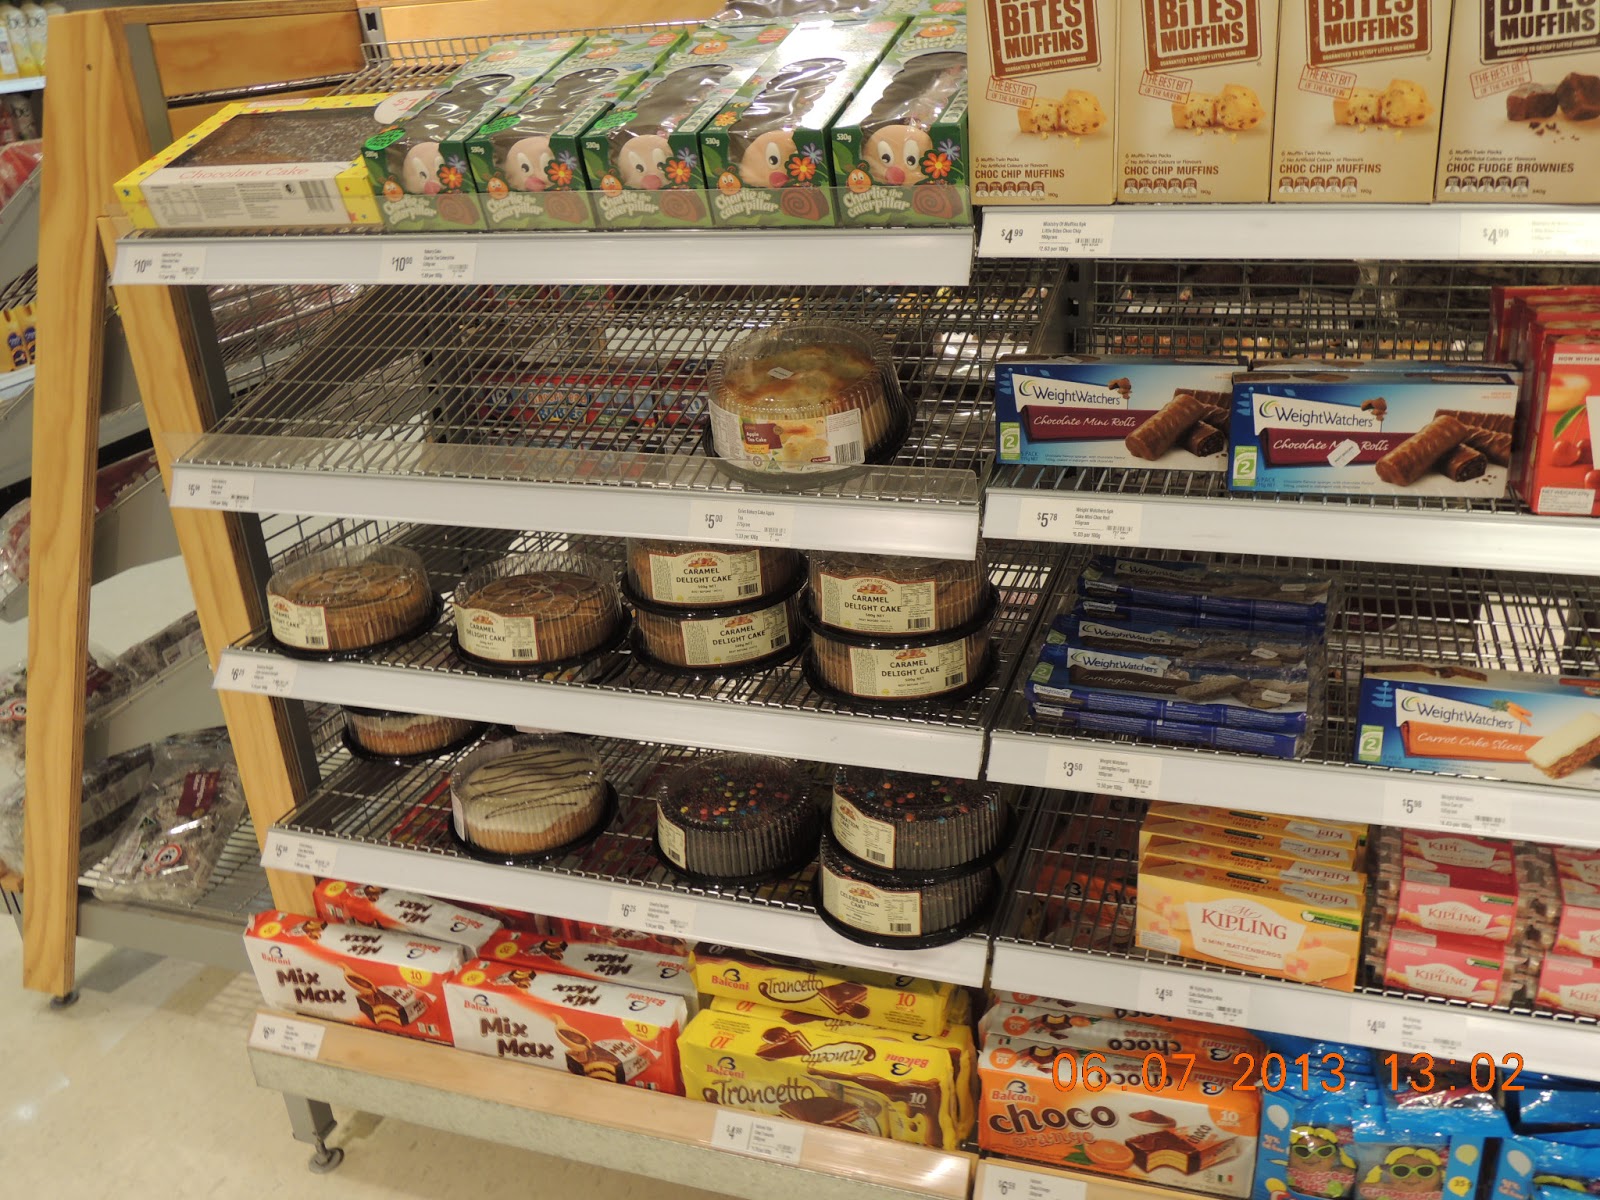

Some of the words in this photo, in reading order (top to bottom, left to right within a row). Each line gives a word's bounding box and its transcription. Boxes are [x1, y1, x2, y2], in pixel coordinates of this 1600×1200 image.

[1001, 0, 1082, 37] BiTES
[1500, 9, 1595, 41] MUFFINS
[1160, 22, 1244, 53] MUFFINS
[1324, 14, 1414, 46] MUFFINS
[1004, 29, 1084, 60] MUFFINS
[1378, 46, 1392, 54] LITTLE
[1306, 68, 1320, 80] THE
[1320, 71, 1339, 84] BEST
[1340, 74, 1352, 86] BIT
[1491, 67, 1510, 81] BEST
[991, 80, 1004, 91] THE
[1004, 82, 1020, 94] BEST
[1021, 85, 1033, 97] BIT
[1145, 74, 1158, 86] THE
[1158, 76, 1176, 90] BEST
[1176, 80, 1188, 92] BIT
[705, 138, 720, 146] 530g
[836, 133, 852, 142] 530g
[586, 142, 600, 150] 530g
[179, 166, 264, 180] Chocolate
[268, 166, 308, 176] Cake
[975, 170, 998, 179] CHOC
[1002, 170, 1022, 178] CHIP
[1024, 168, 1064, 178] MUFFINS
[1124, 166, 1149, 175] CHOC
[1152, 166, 1174, 175] CHIP
[1177, 166, 1219, 175] MUFFINS
[1280, 164, 1306, 174] CHOC
[1310, 164, 1332, 174] CHIP
[1336, 164, 1382, 174] MUFFINS
[1446, 163, 1475, 172] CHOC
[1478, 163, 1513, 172] FUDGE
[1516, 163, 1574, 172] BROWNIES
[600, 190, 638, 210] Charlie
[715, 188, 756, 209] Charlie
[756, 190, 772, 200] the
[843, 186, 888, 208] Charlie
[888, 188, 903, 198] the
[605, 201, 658, 222] caterpillar
[720, 199, 778, 220] caterpillar
[848, 197, 910, 218] caterpillar
[1032, 386, 1121, 406] WeightWatchers
[1034, 416, 1081, 426] Chocolate
[1084, 416, 1109, 426] Mini
[1112, 416, 1136, 428] Rolls
[1275, 406, 1374, 428] WeightWatchers
[1006, 434, 1015, 448] 2
[1273, 438, 1327, 450] Chocolate
[1361, 440, 1390, 452] Rolls
[1240, 462, 1250, 474] 2
[705, 514, 723, 529] $500
[1037, 512, 1058, 528] $578
[676, 576, 710, 584] DELIGHT
[852, 594, 889, 604] CARAMEL
[844, 602, 878, 612] DELIGHT
[470, 623, 496, 633] CARAMEL
[720, 626, 755, 636] CARAMEL
[712, 636, 746, 646] DELIGHT
[748, 630, 766, 640] CAKE
[1094, 627, 1166, 646] WeightWatchers
[890, 660, 928, 668] CARAMEL
[920, 666, 940, 674] CAKE
[1082, 656, 1158, 674] WeightWatchers
[1416, 702, 1516, 730] WeightWatchers
[1366, 738, 1376, 750] 2
[1417, 732, 1457, 744] Carrot
[1459, 736, 1489, 747] Cake
[1492, 739, 1524, 752] Slices
[1063, 761, 1082, 776] $350
[1299, 867, 1350, 882] KIPLING
[840, 890, 880, 908] CELEBRATION
[850, 901, 866, 910] CAKE
[399, 911, 432, 924] Mix
[621, 904, 637, 918] $625
[1428, 908, 1482, 925] KIPLING
[1201, 908, 1288, 940] KIPLING
[341, 934, 382, 944] Max
[347, 944, 382, 956] Mix
[1208, 939, 1226, 948] MINI
[1226, 942, 1282, 959] BATTENBERGS
[261, 952, 292, 966] Balconi
[584, 953, 628, 964] Max
[276, 968, 320, 987] Mix
[410, 970, 422, 981] 10
[594, 964, 632, 976] Mix
[1415, 968, 1468, 987] KIPLING
[552, 984, 598, 994] Max
[711, 975, 750, 992] Balconi
[766, 974, 824, 996] Trancetto
[295, 988, 347, 1004] Max
[562, 994, 602, 1006] Mix
[626, 992, 666, 1007] Balconi
[897, 992, 916, 1007] 10
[1156, 988, 1173, 1002] $450
[464, 1000, 498, 1014] Balconi
[480, 1017, 528, 1038] Mix
[635, 1024, 648, 1035] 10
[498, 1038, 554, 1060] Max
[1108, 1038, 1182, 1056] choco
[800, 1048, 868, 1066] Trancetto
[885, 1053, 929, 1068] Balconi
[706, 1064, 744, 1080] Balconi
[712, 1076, 814, 1105] Trancetto
[908, 1092, 927, 1104] 10
[992, 1090, 1036, 1104] Balconi
[989, 1102, 1117, 1134] choco
[1220, 1110, 1239, 1122] 10
[1012, 1130, 1097, 1148] orange
[1187, 1124, 1212, 1145] choco
